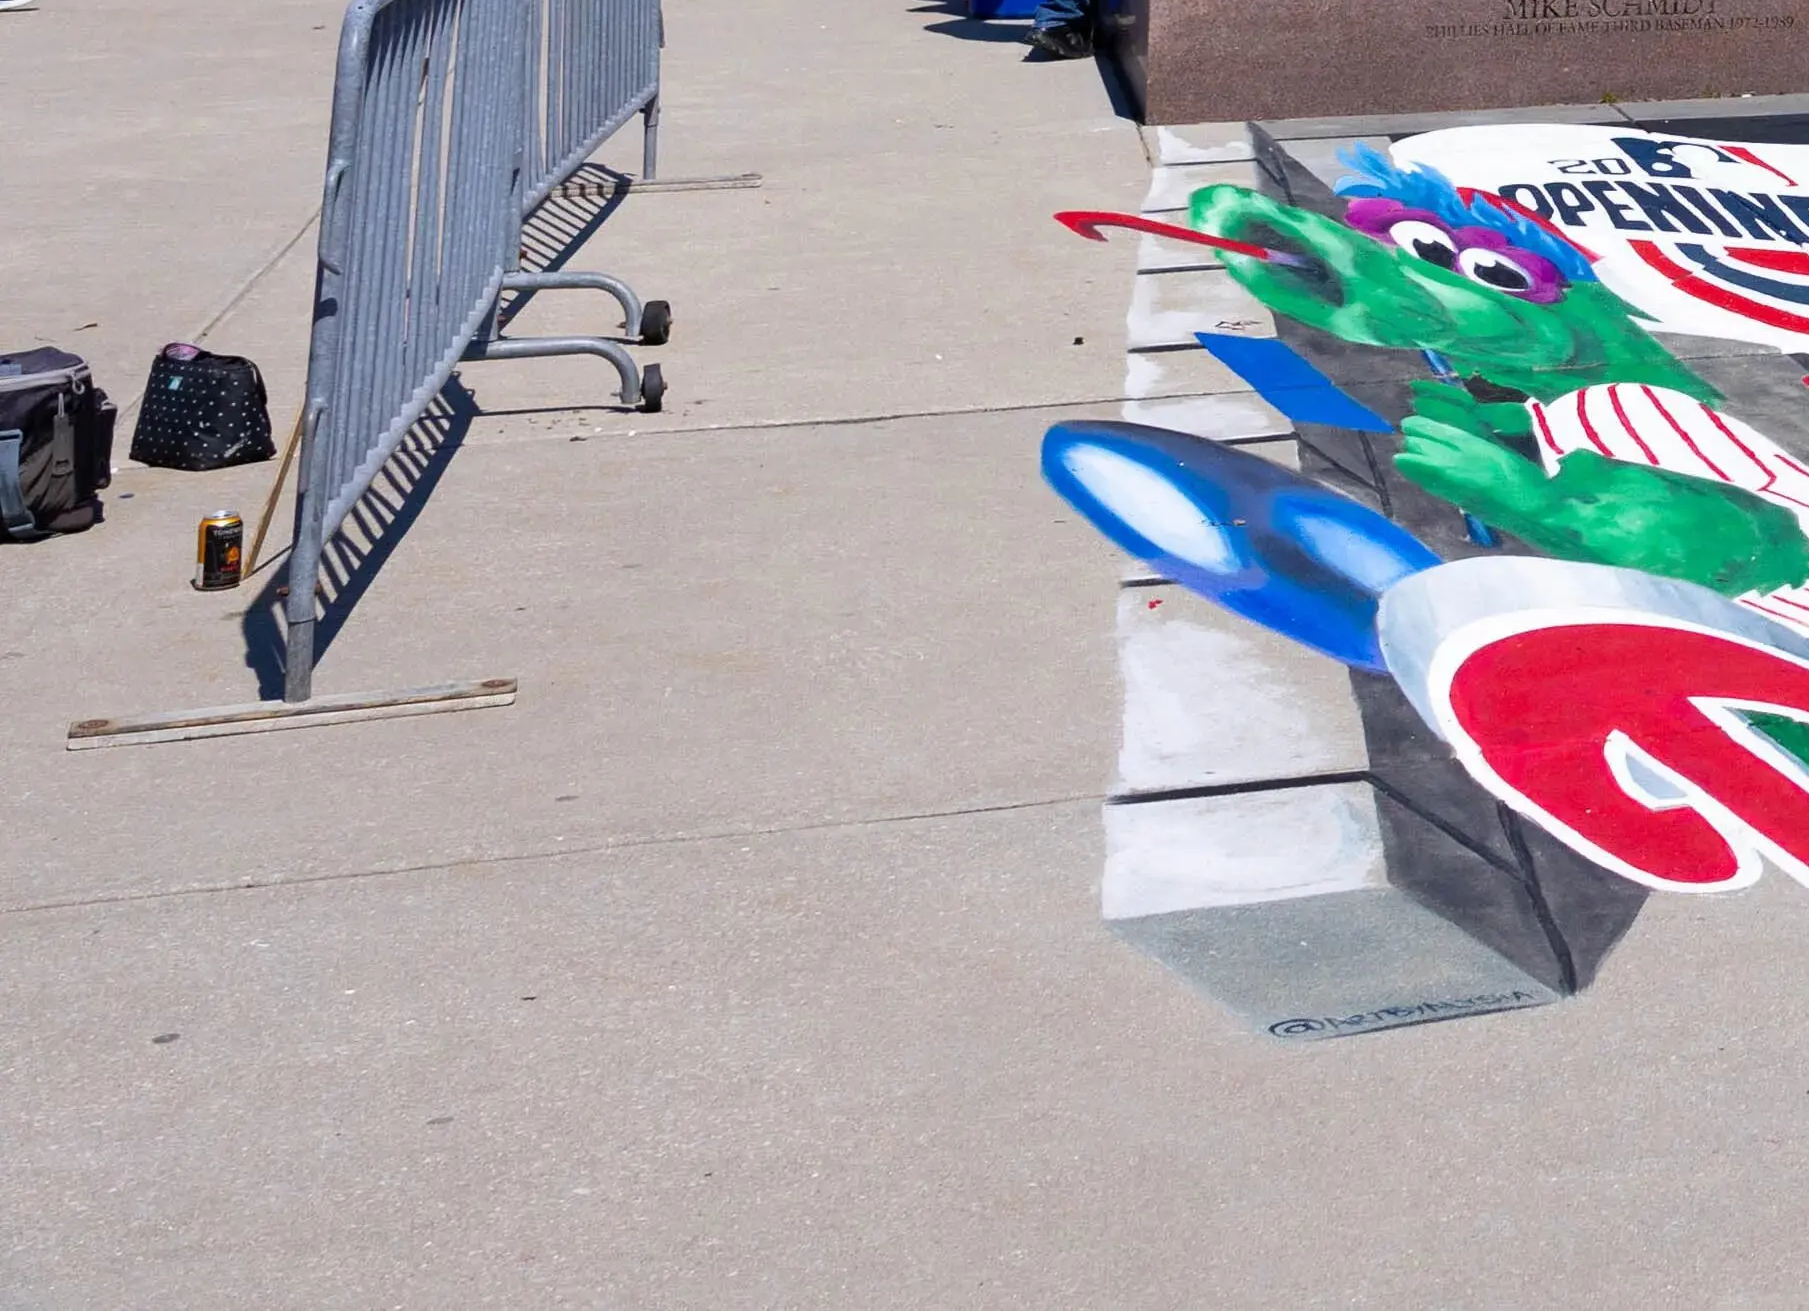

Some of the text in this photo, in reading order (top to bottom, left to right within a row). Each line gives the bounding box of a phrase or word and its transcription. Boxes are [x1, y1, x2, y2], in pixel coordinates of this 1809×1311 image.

[1493, 22, 1530, 36] HALL
[1558, 20, 1600, 34] FAME
[1603, 19, 1651, 33] THIRD
[1655, 16, 1726, 31] BASEMAN
